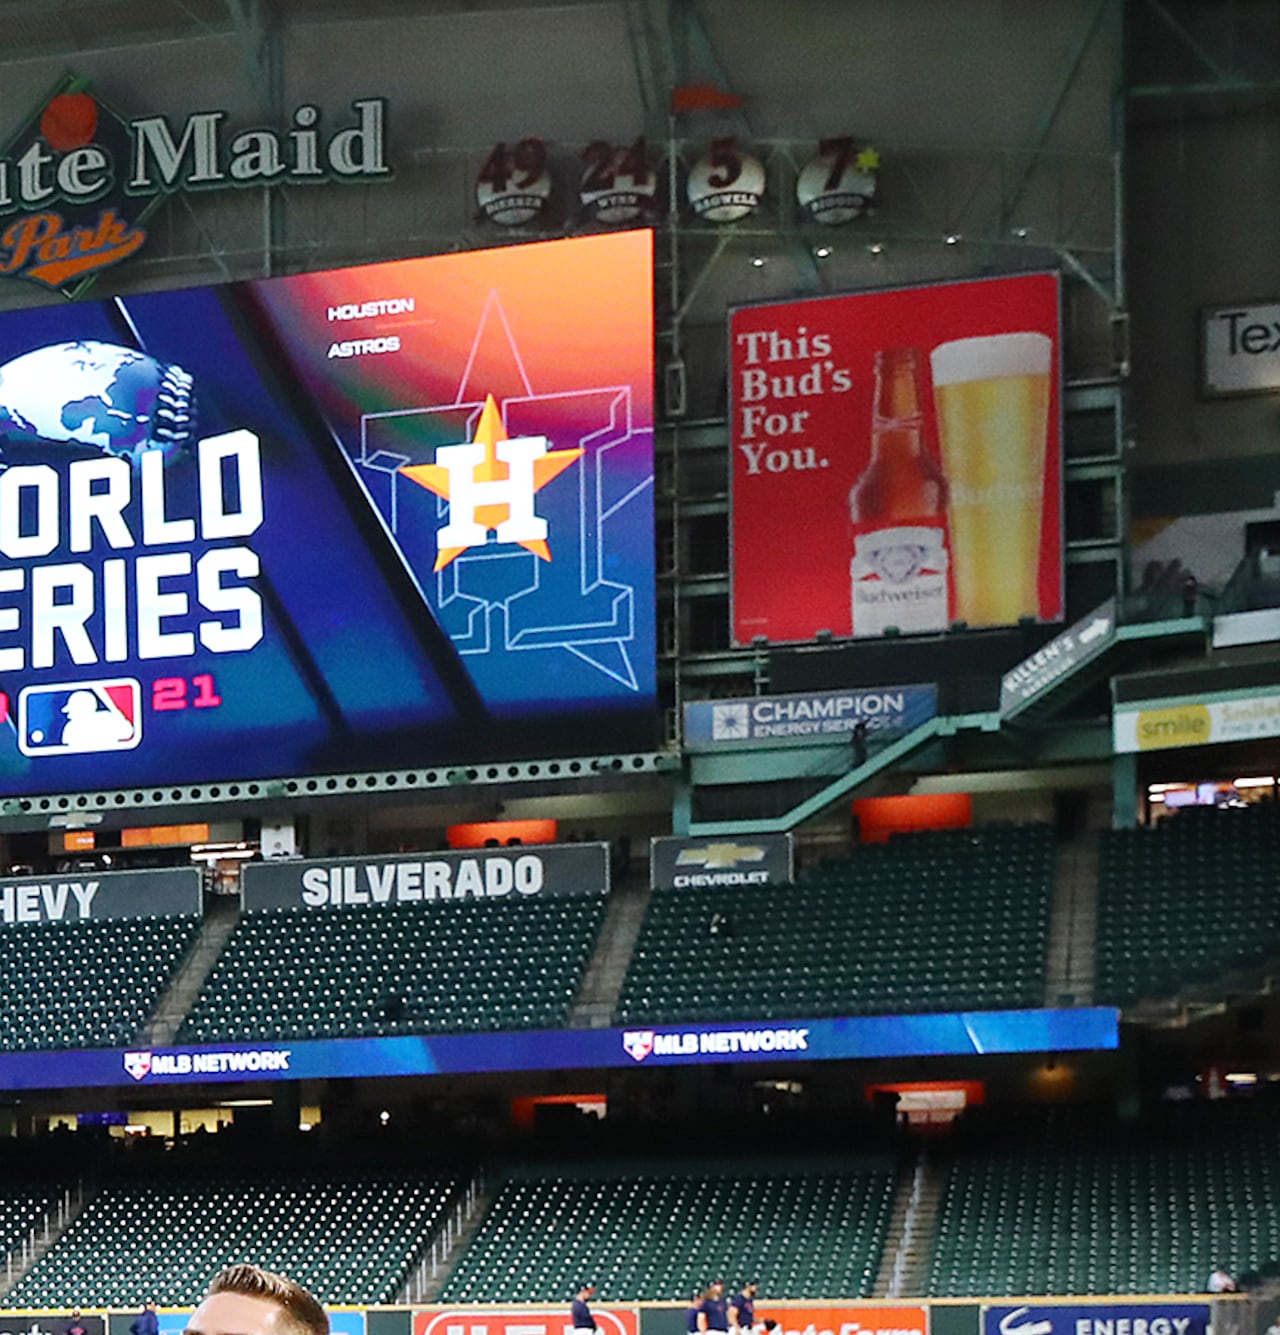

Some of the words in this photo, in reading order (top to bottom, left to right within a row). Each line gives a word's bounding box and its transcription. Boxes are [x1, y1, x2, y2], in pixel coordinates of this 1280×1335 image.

[130, 100, 389, 187] Maid
[478, 137, 546, 193] 49
[581, 136, 651, 192] 24
[708, 136, 742, 188] 5
[819, 135, 854, 191] 7
[327, 297, 415, 321] HOUSTON
[327, 336, 401, 358] ASTROS
[737, 326, 833, 365] This
[740, 361, 853, 402] Bud's
[740, 405, 810, 439] For
[739, 442, 830, 475] You.
[435, 436, 548, 550] H
[152, 674, 222, 711] 21
[752, 693, 905, 723] CHAMPION
[754, 722, 820, 738] ENERGY
[1141, 714, 1205, 739] smile
[302, 855, 545, 907] SILVERADO
[673, 871, 770, 888] CHEVROLET
[653, 1034, 698, 1055] MLB
[699, 1029, 809, 1053] NETWORK
[151, 1054, 192, 1075] MLB
[193, 1051, 292, 1073] NETWORK
